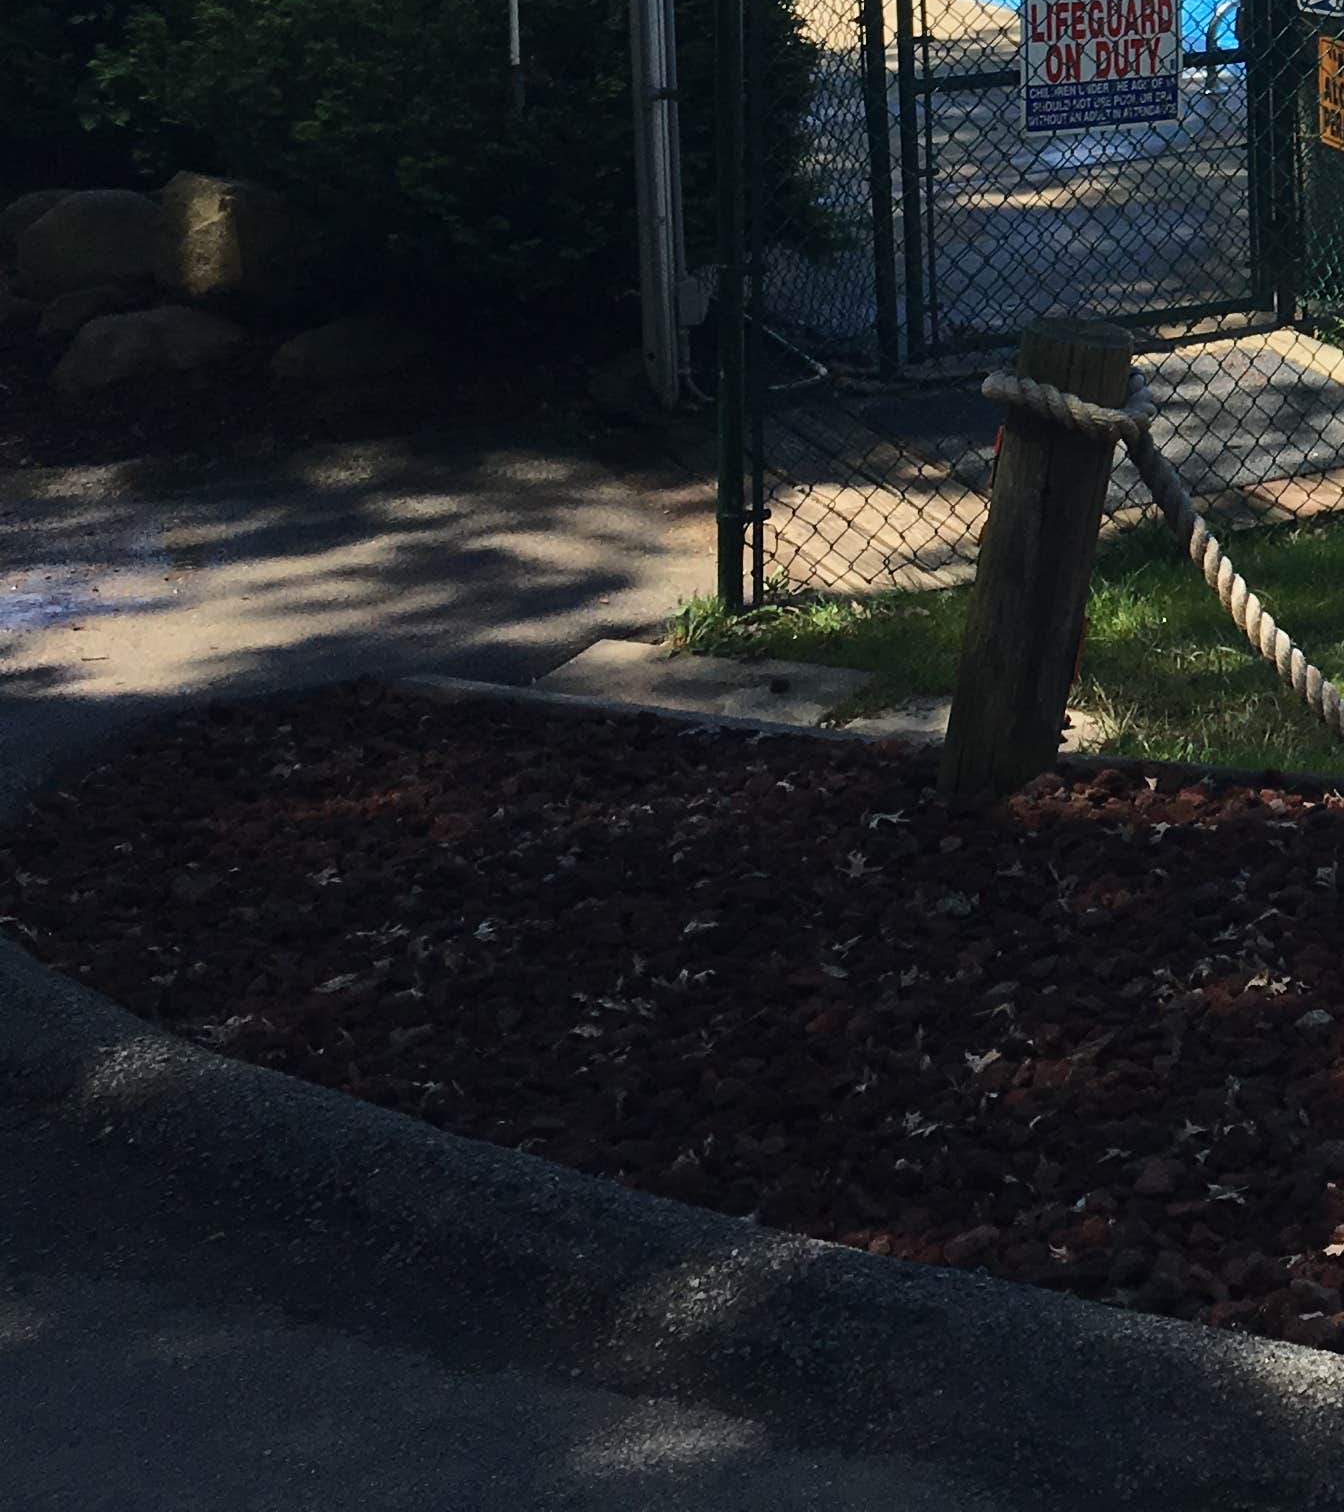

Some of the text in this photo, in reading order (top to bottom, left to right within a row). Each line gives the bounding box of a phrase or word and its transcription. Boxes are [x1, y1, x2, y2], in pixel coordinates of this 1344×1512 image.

[1045, 37, 1160, 83] ON DUTY
[1029, 85, 1076, 99] CHILREN
[1151, 77, 1163, 88] OF
[1032, 100, 1070, 113] SHOULD
